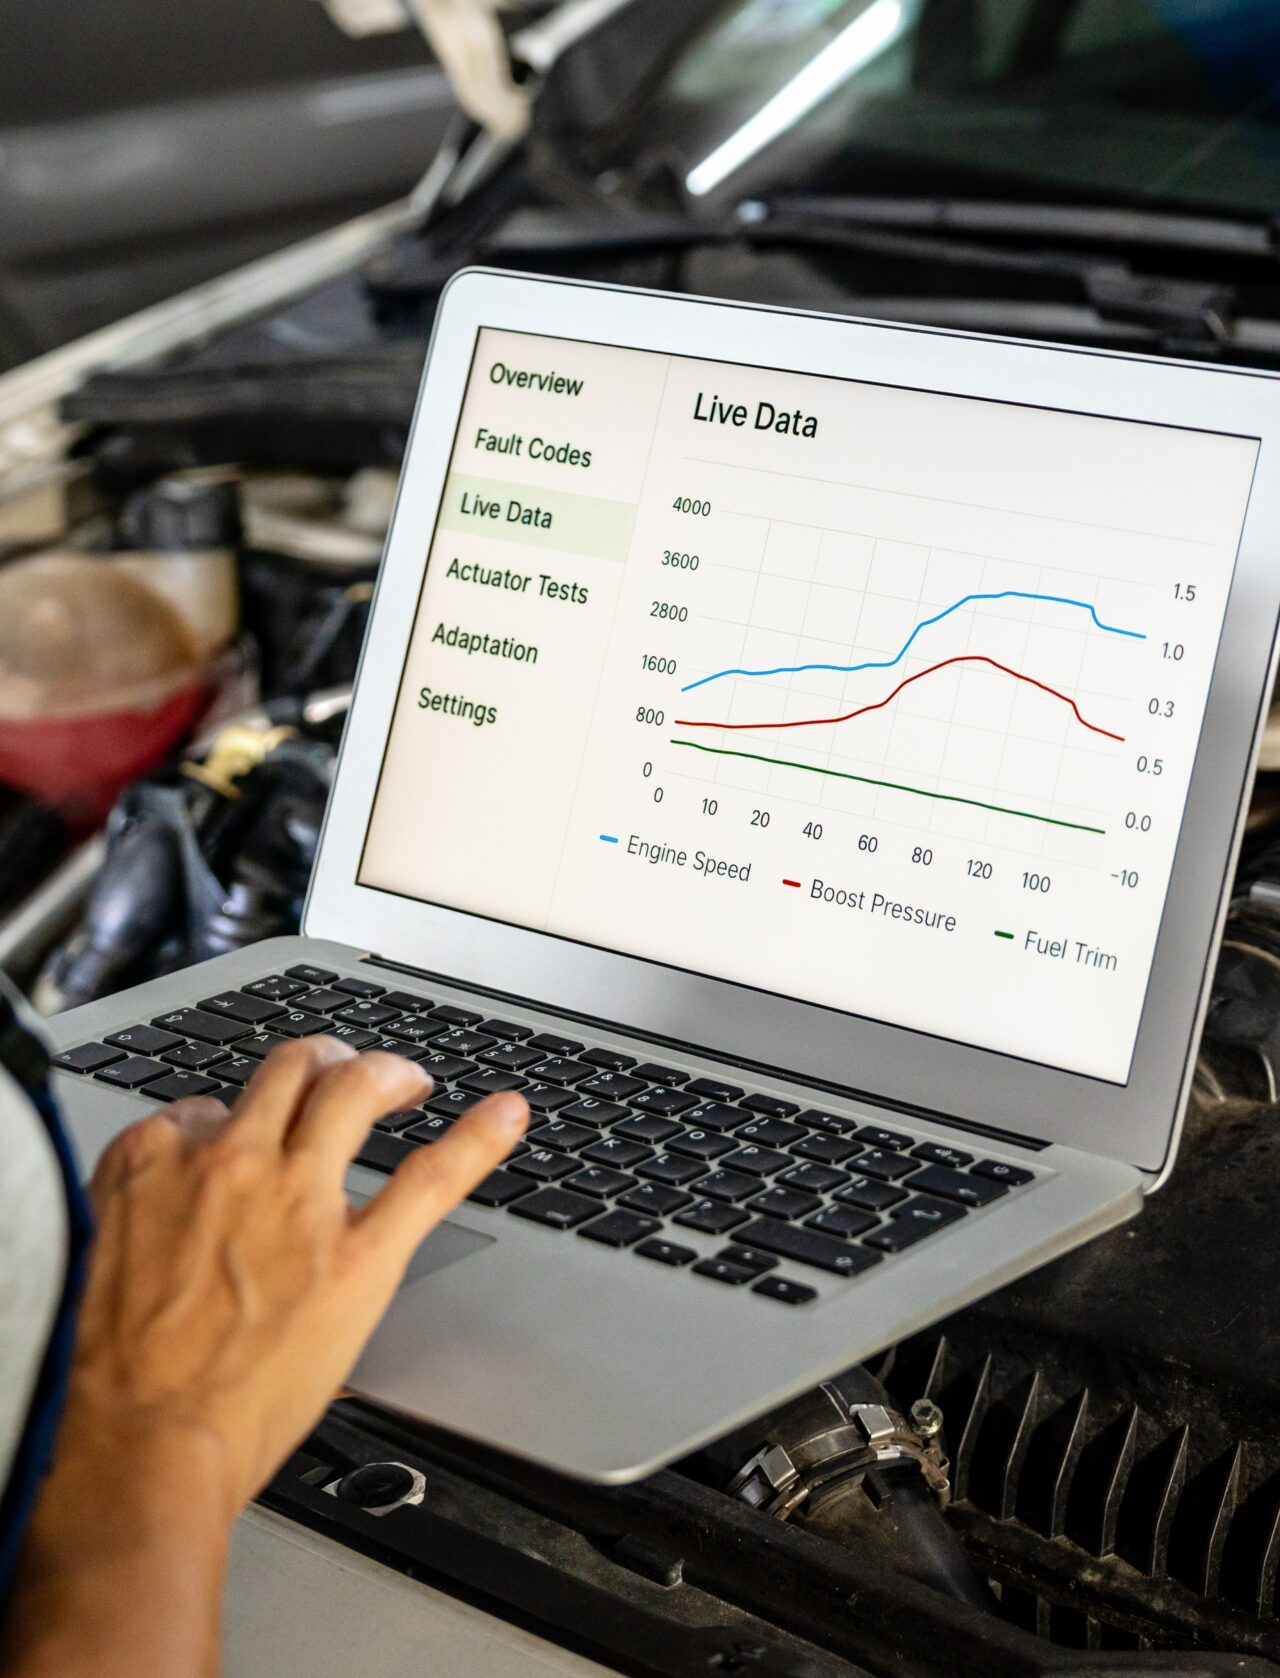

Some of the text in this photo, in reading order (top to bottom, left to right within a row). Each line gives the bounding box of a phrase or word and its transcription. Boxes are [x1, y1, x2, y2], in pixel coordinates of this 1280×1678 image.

[489, 362, 585, 397] Overview
[693, 392, 818, 439] Live Data
[474, 428, 592, 468] Fault Codes
[460, 492, 553, 529] Live Data
[672, 496, 712, 517] 4000
[661, 550, 700, 571] 3600
[445, 557, 589, 605] Actuator Tests
[1174, 582, 1197, 602] 1.5
[649, 600, 689, 623] 2800
[431, 622, 538, 664] Adaptation
[1163, 642, 1185, 662] 1.0
[641, 654, 677, 675] 1600
[417, 686, 498, 727] Settings
[635, 706, 665, 727] 800
[1148, 697, 1175, 718] 0.3
[641, 761, 653, 778] 0
[1136, 755, 1164, 776] 0.5
[1124, 811, 1152, 833] 0.0
[653, 787, 1051, 893] 0 10 20 40 60 80 120 100
[627, 834, 752, 883] Engine Speed
[1110, 869, 1139, 890] -10
[810, 878, 957, 932] Boost Pressure
[1024, 930, 1118, 972] Fuel Trim
[289, 1012, 305, 1022] Q
[254, 1033, 269, 1043] A
[336, 1025, 355, 1036] W
[382, 1040, 398, 1049] E
[231, 1058, 250, 1067] Z
[429, 1054, 446, 1063] R
[481, 1068, 497, 1078] T
[449, 1091, 466, 1102] G
[533, 1084, 548, 1093] Y
[582, 1099, 600, 1108] U
[428, 1118, 444, 1128] B
[550, 1123, 566, 1132] J
[603, 1138, 622, 1149] K
[689, 1131, 706, 1140] O
[531, 1151, 553, 1162] M
[656, 1154, 669, 1165] L
[742, 1146, 759, 1155] P
